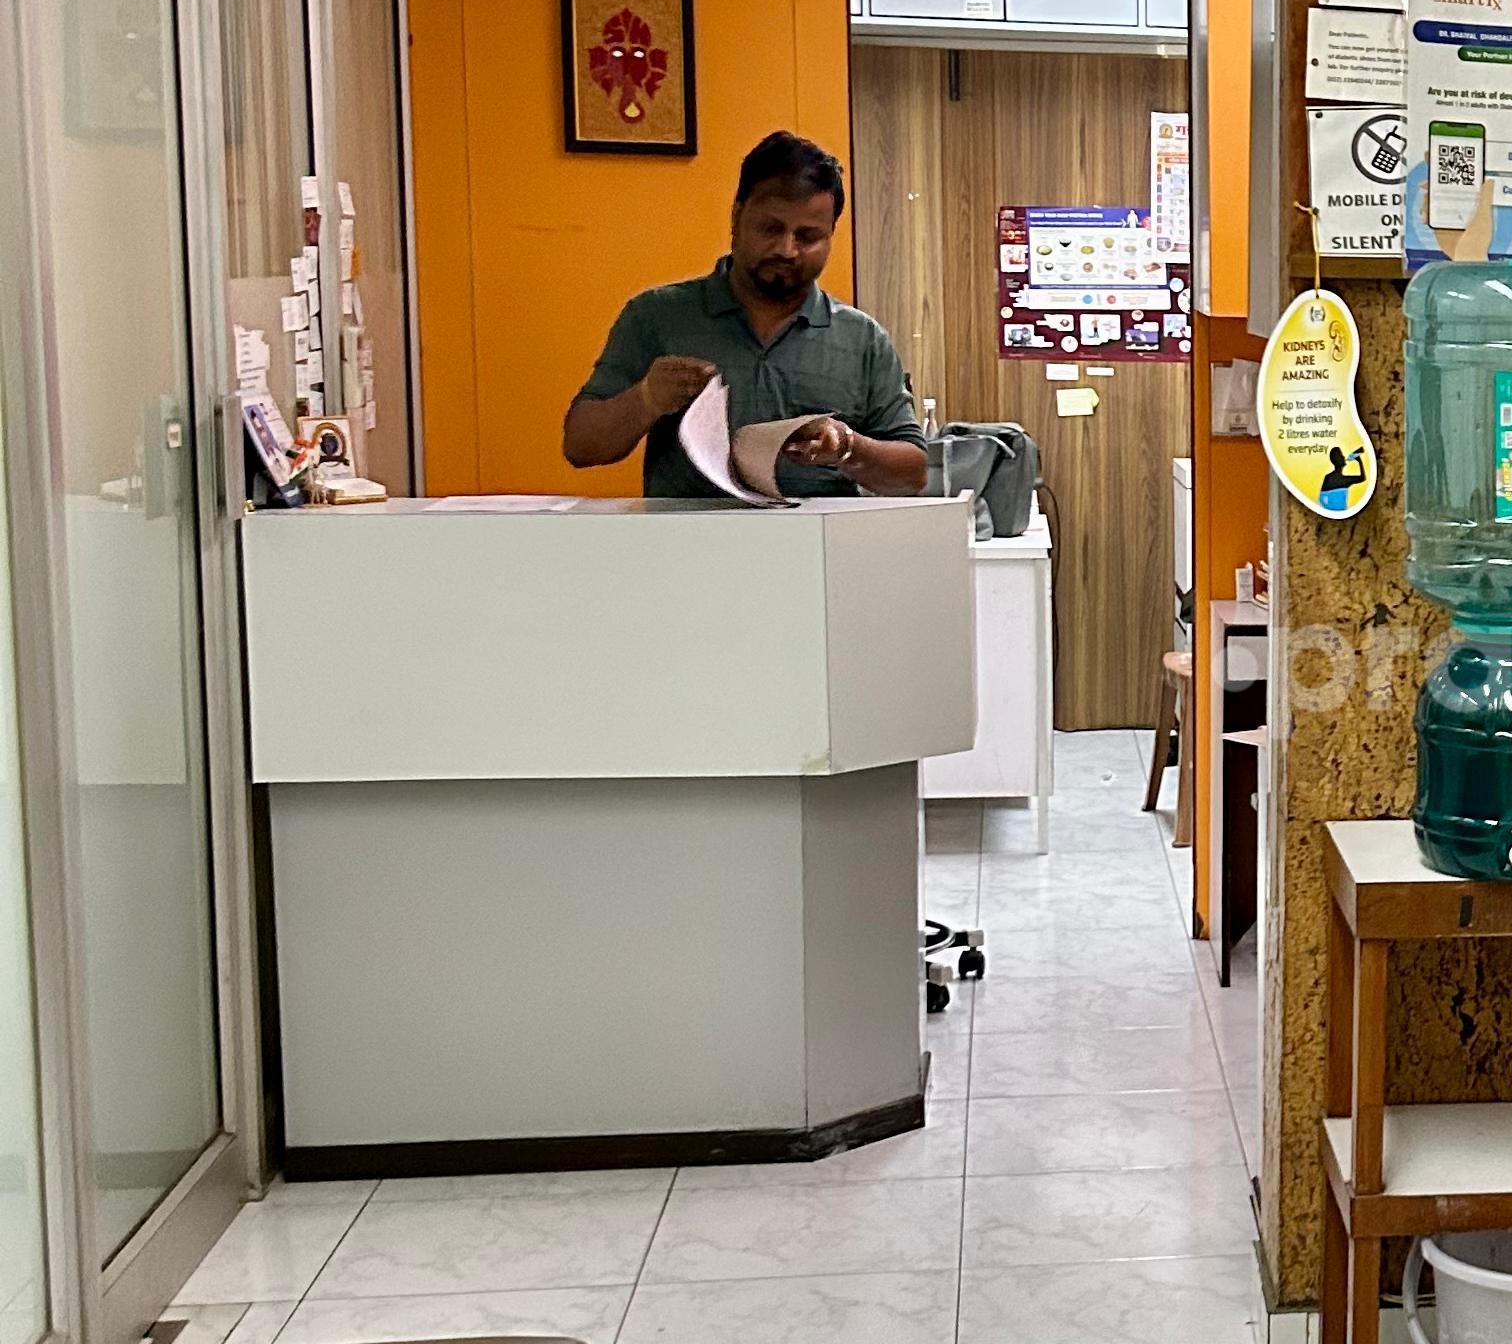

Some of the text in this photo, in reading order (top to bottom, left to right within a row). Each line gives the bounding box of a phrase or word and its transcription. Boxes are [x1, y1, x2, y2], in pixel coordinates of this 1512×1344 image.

[1467, 51, 1483, 59] Your
[1483, 52, 1509, 60] Partner
[1427, 86, 1441, 97] Are
[1444, 89, 1458, 98] you
[1460, 89, 1469, 98] at
[1471, 90, 1487, 99] risk
[1489, 91, 1497, 100] of
[1328, 194, 1388, 207] MOBILE
[1381, 214, 1403, 226] ON
[1331, 235, 1395, 249] SILENT
[1283, 340, 1326, 353] KIDNEYS
[1295, 355, 1316, 366] ARE
[1282, 369, 1329, 381] AMAZING
[1272, 397, 1343, 411] Help to detoxify
[1282, 413, 1333, 426] by drinking
[1278, 428, 1338, 440] 2 litres water
[1288, 443, 1329, 455] everyday
